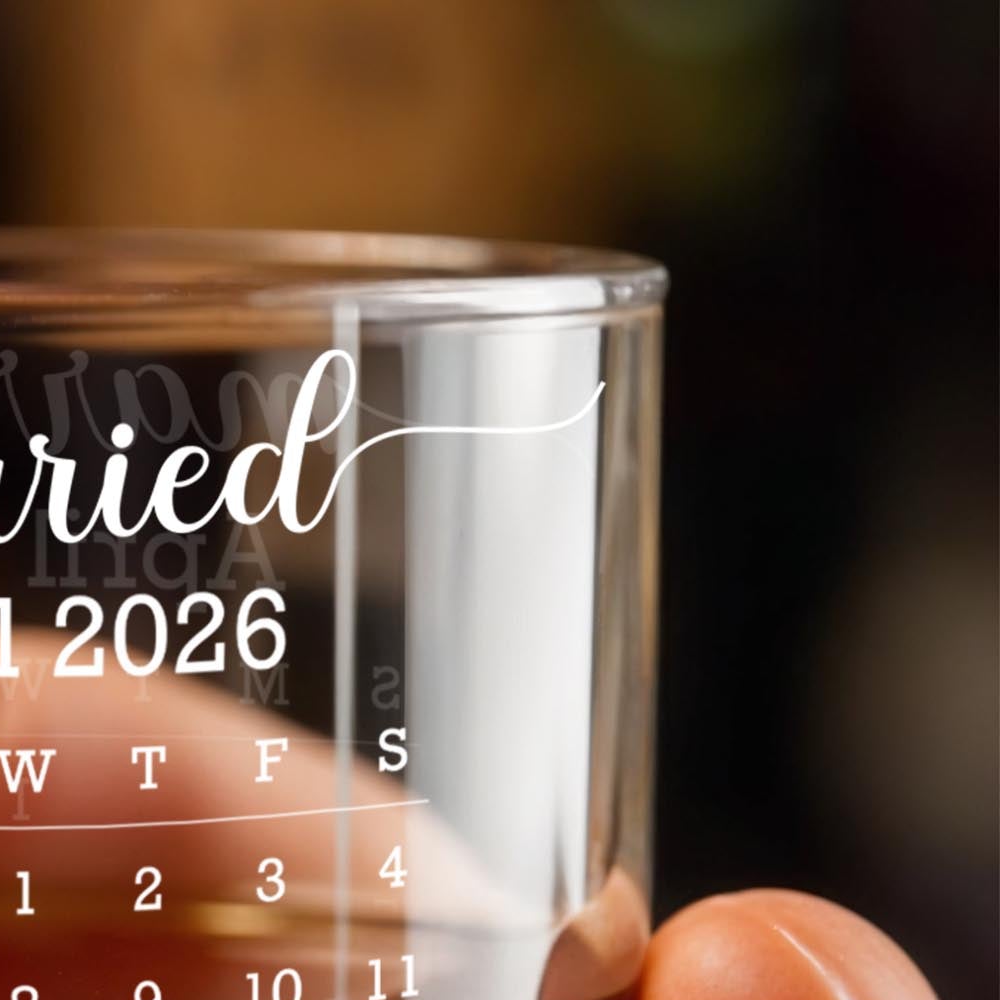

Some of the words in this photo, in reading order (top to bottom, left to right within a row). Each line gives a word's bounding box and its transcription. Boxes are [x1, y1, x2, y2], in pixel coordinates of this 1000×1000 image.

[53, 588, 287, 677] 2026
[131, 745, 167, 790] T
[254, 737, 290, 783] F
[378, 727, 409, 771] S
[16, 872, 35, 914] 1
[134, 867, 162, 911] 2
[256, 857, 287, 902] 3
[379, 845, 408, 888] 4
